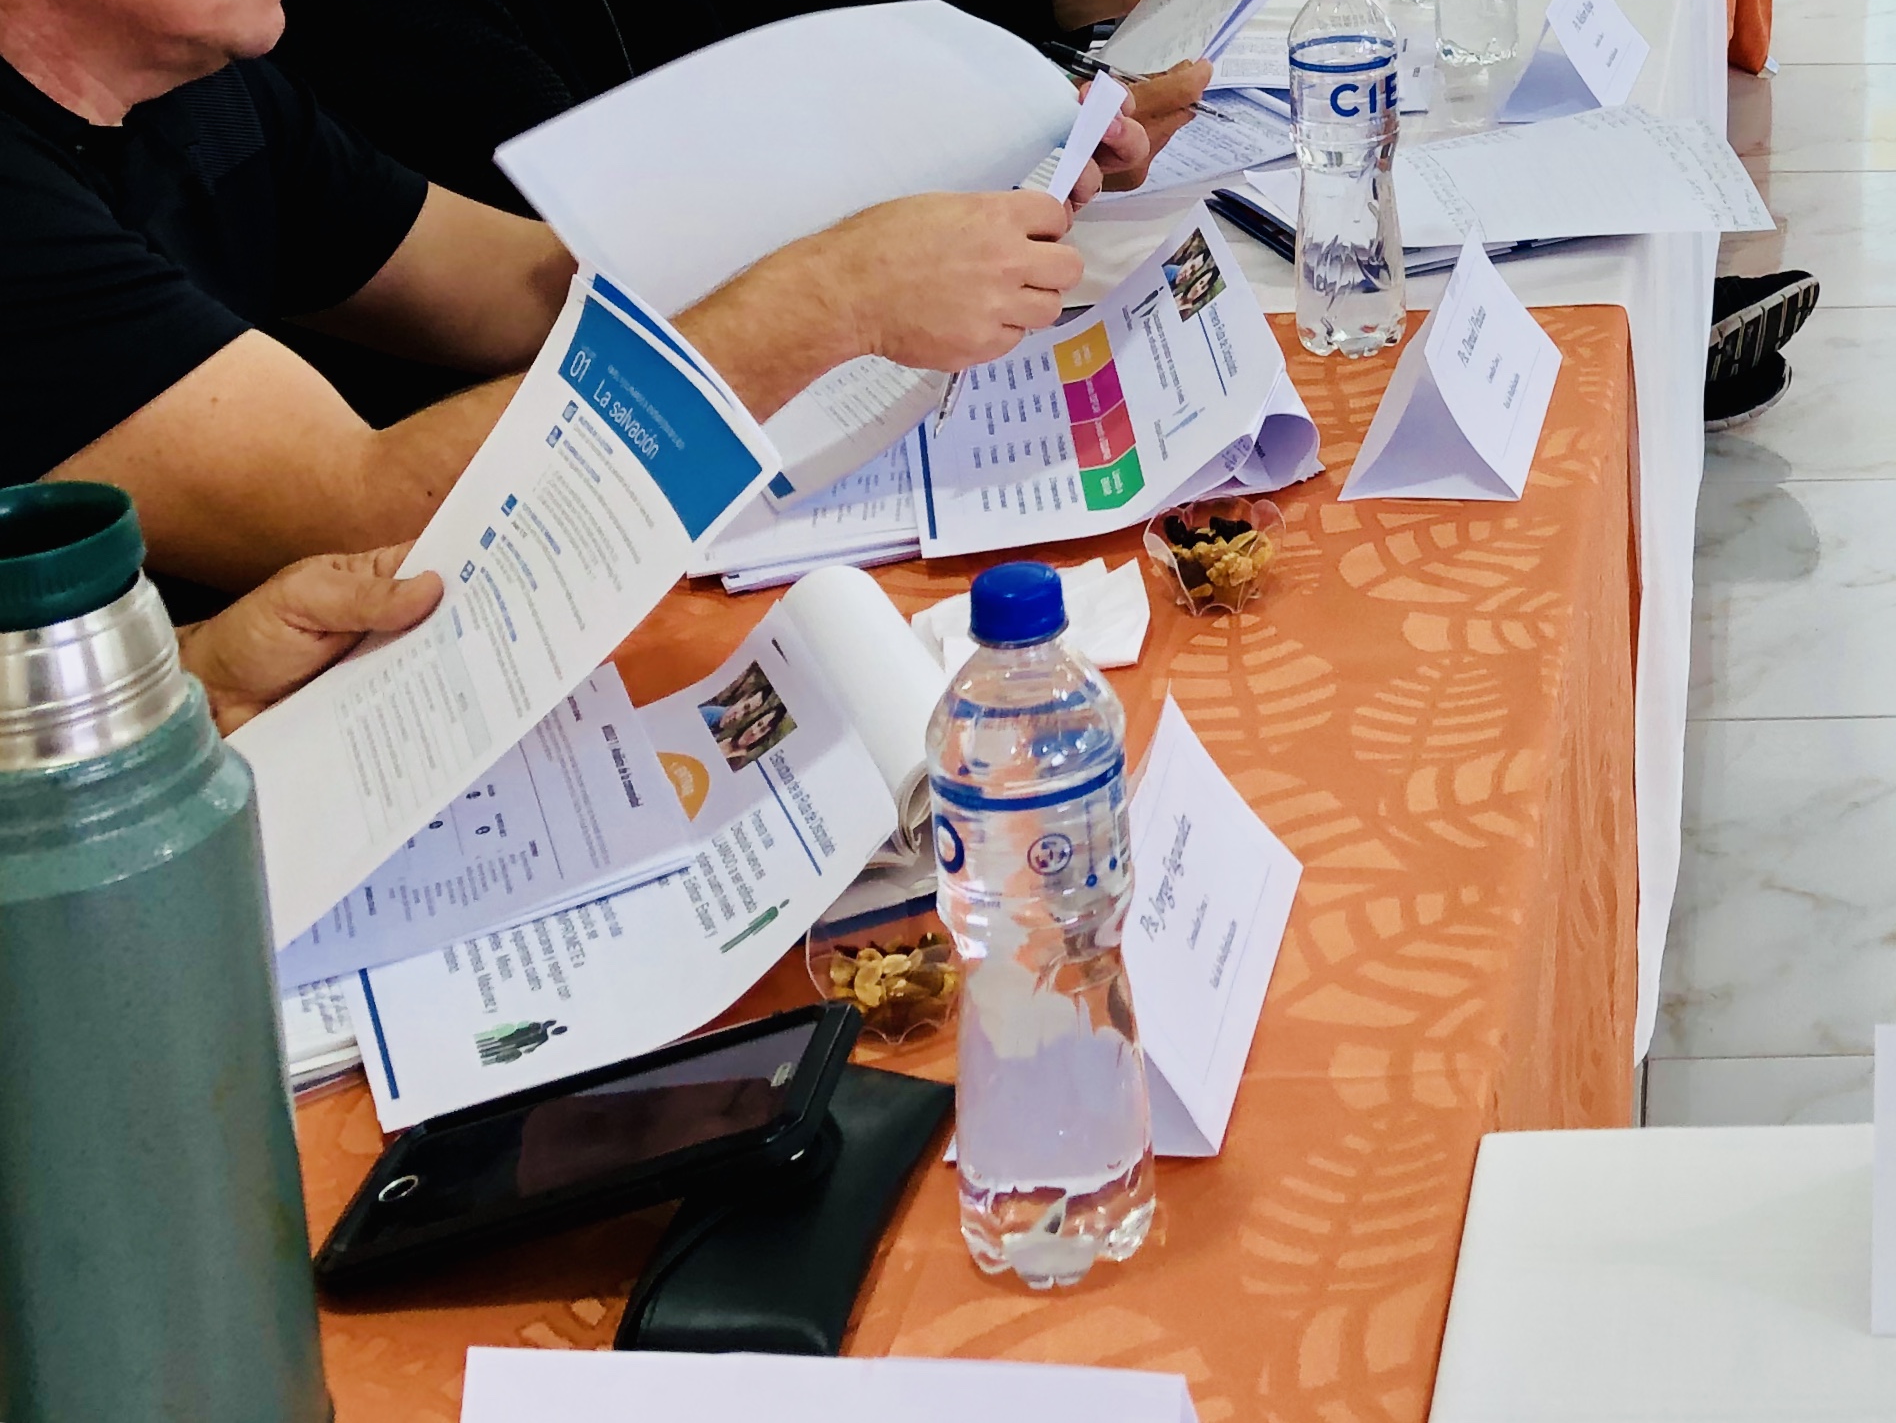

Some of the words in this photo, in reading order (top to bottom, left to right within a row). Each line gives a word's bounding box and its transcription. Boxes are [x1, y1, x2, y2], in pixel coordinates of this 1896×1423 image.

[570, 351, 591, 383] 01
[593, 379, 611, 408] La
[609, 401, 659, 460] salvación
[1149, 874, 1175, 931] Jorge
